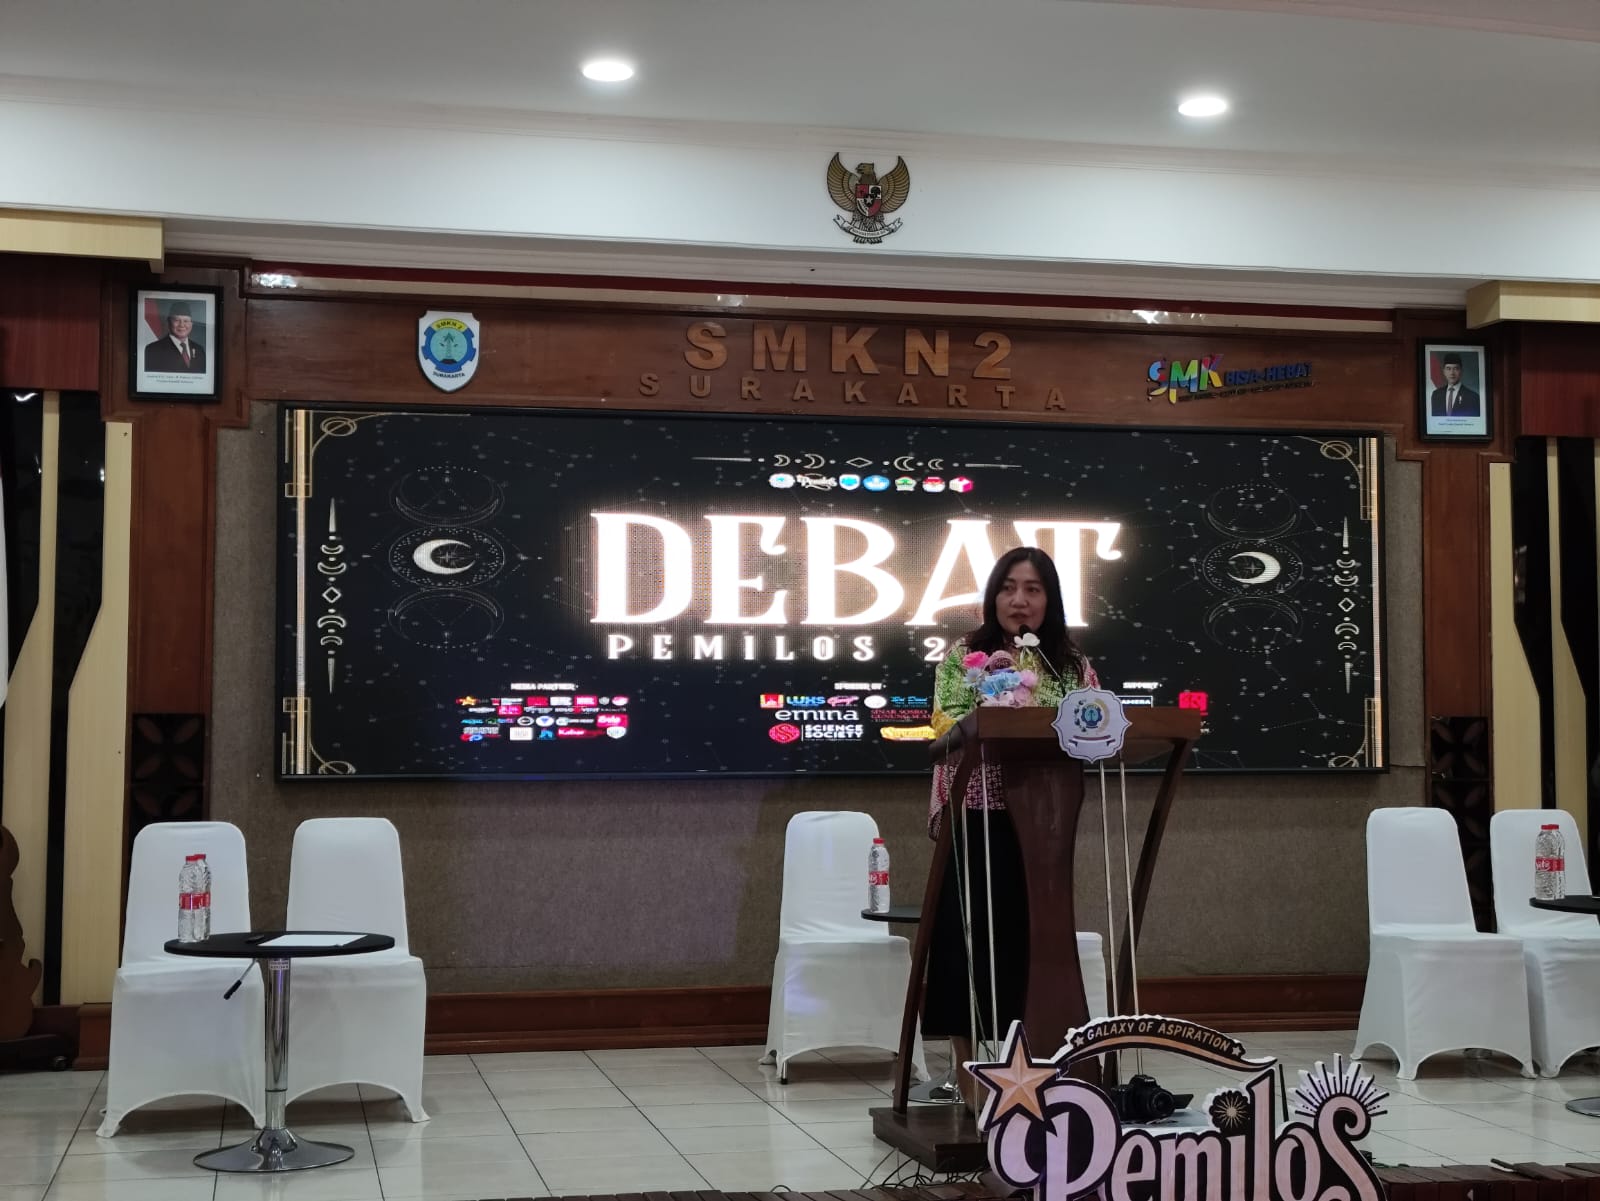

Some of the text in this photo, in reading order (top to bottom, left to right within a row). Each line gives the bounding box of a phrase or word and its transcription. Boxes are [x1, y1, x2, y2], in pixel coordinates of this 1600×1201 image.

[684, 321, 1012, 380] SMKN 2
[639, 372, 1066, 410] SURAKARTA
[1148, 354, 1224, 402] SMK
[590, 512, 1122, 628] DEBAT
[607, 634, 875, 661] PEMILOS
[775, 710, 859, 721] emina
[1087, 1021, 1231, 1051] GALAXY OF ASPIRATION
